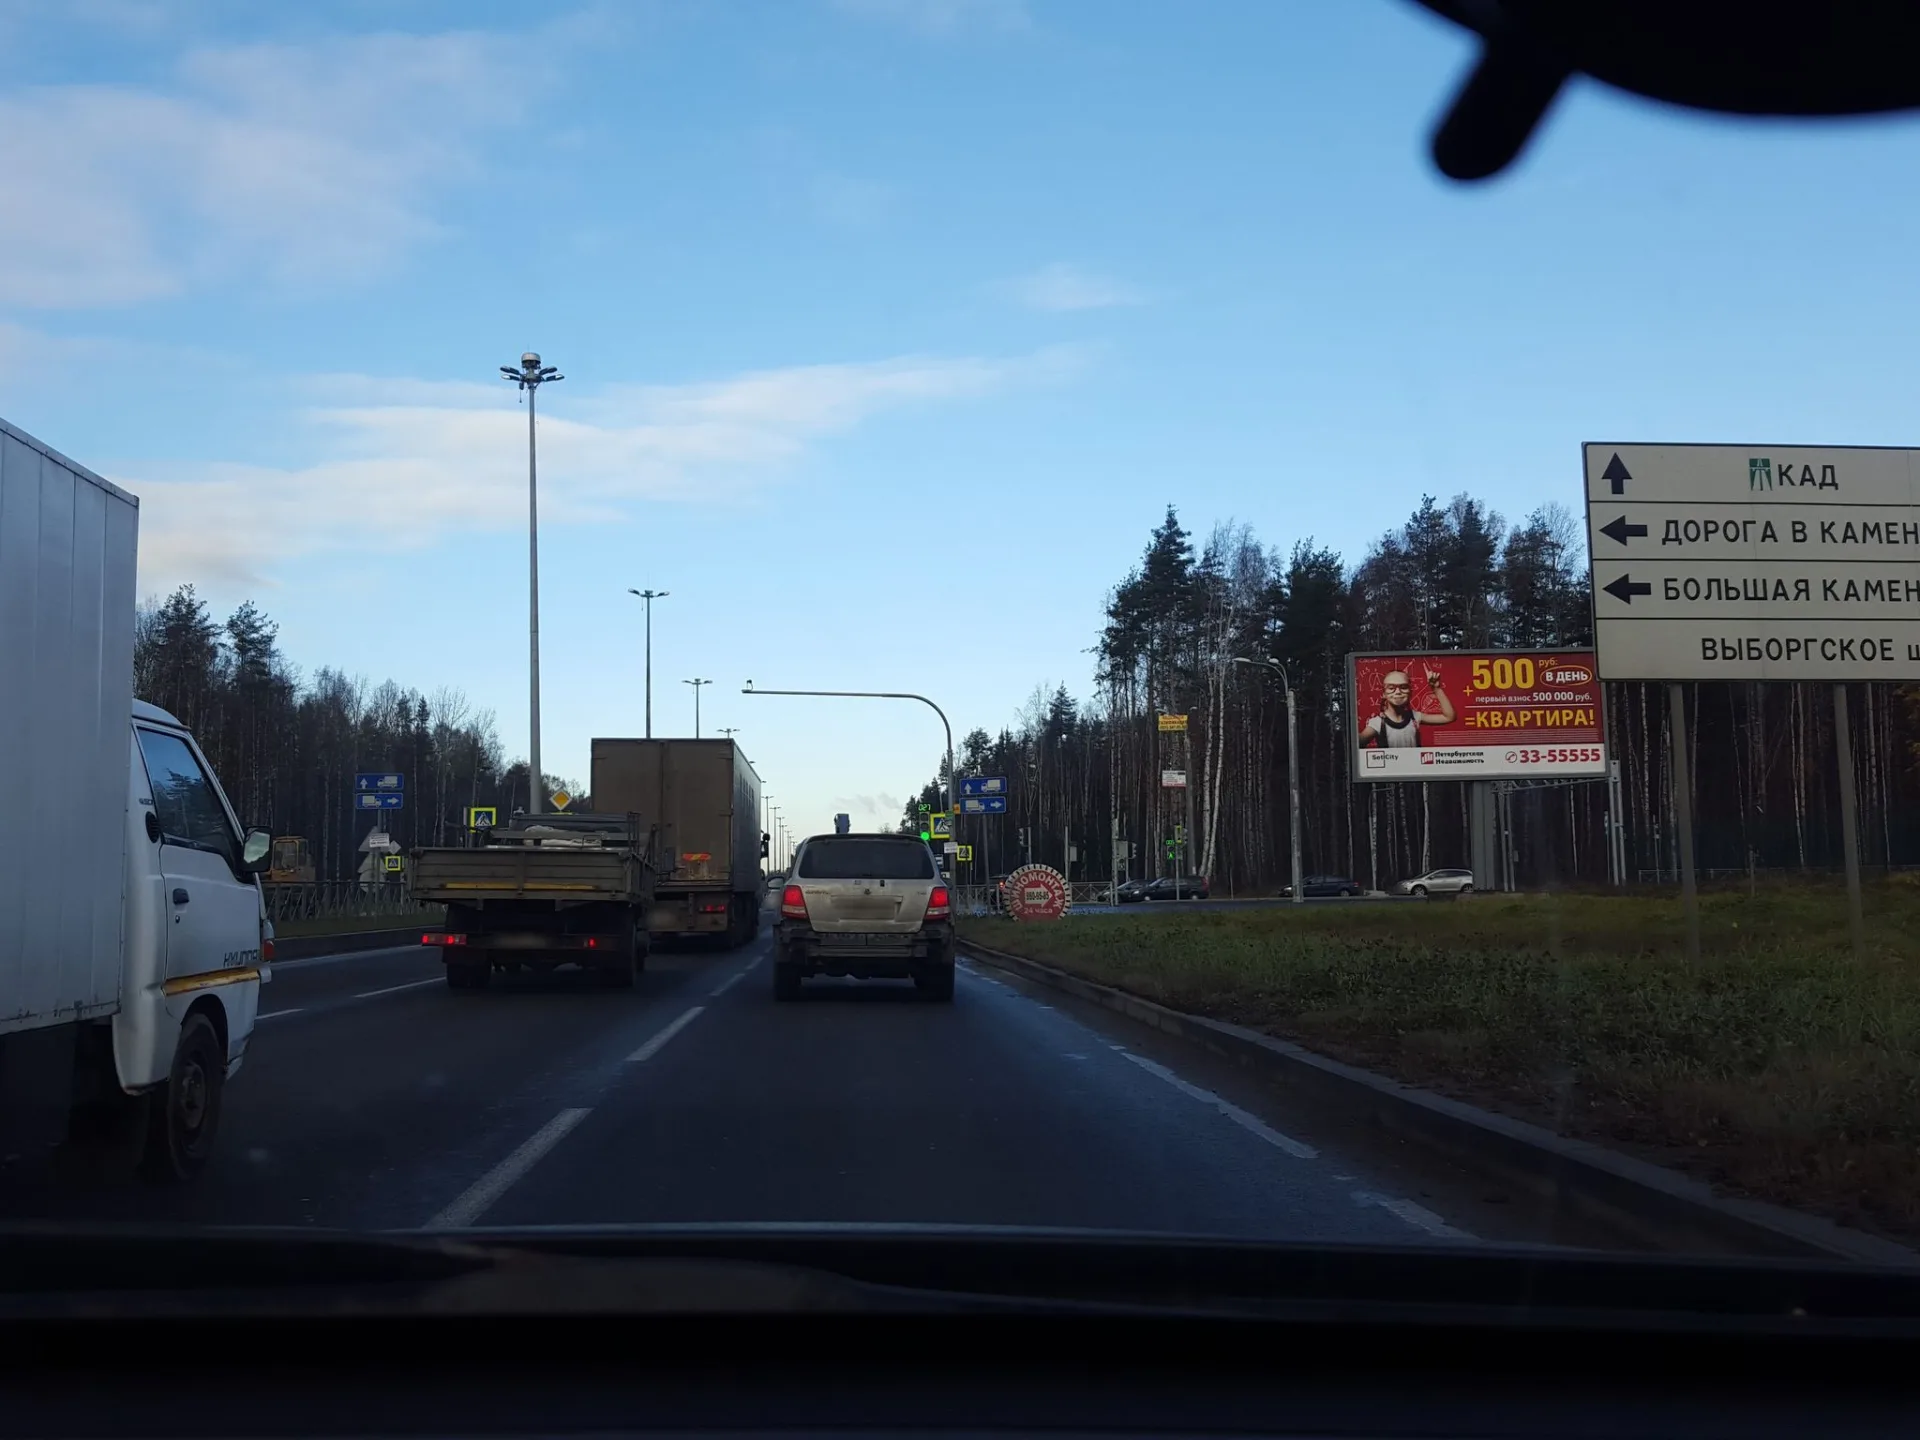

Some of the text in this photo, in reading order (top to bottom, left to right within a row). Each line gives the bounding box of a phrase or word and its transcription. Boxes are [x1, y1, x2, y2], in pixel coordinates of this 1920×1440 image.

[1778, 464, 1839, 491] КАД
[1662, 519, 1920, 546] ДОРОГА В КАМЕН
[1663, 577, 1920, 603] БОЛЬШАЯ КАМЕН
[1701, 637, 1895, 662] ВЫБОРГСКОЕ
[1472, 658, 1535, 690] 500
[1545, 671, 1589, 684] В ДЕНЬ
[1475, 694, 1507, 704] первый
[1508, 695, 1530, 703] взнос
[1532, 691, 1553, 702] 500
[1554, 691, 1574, 701] 000
[1575, 692, 1592, 703] руб.
[1519, 749, 1601, 764] 33-55555
[1011, 871, 1065, 911] ШИНОМОНТАЖ
